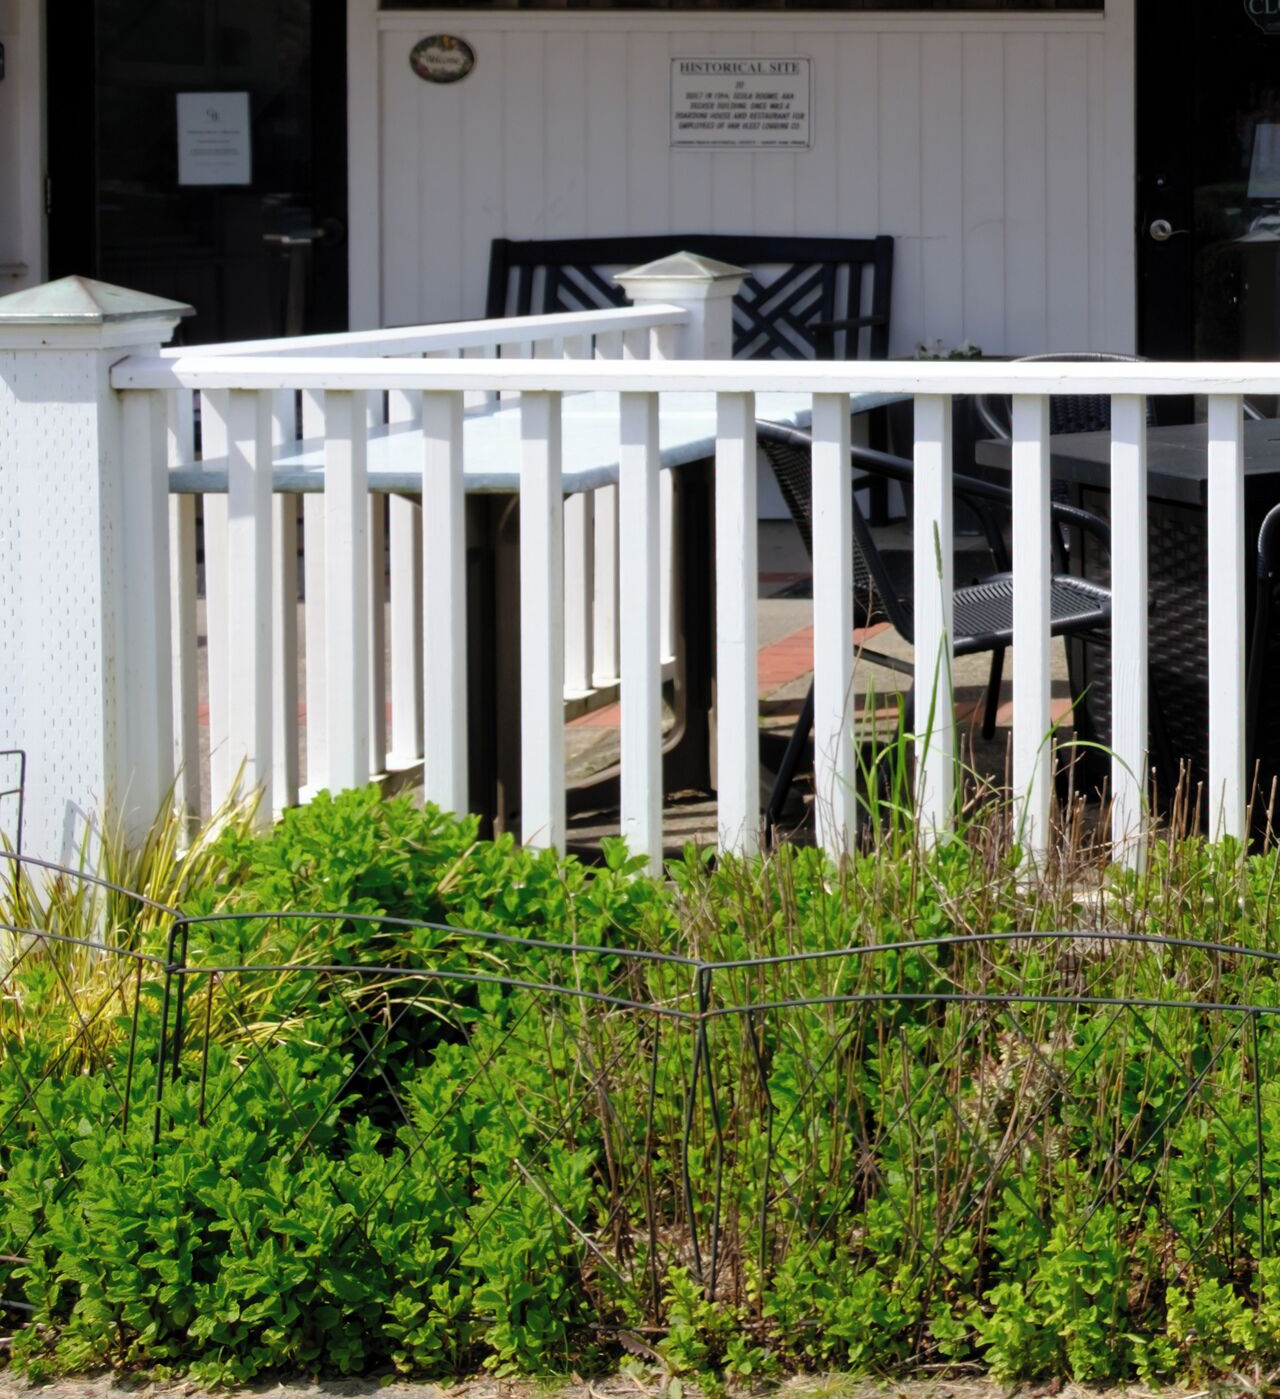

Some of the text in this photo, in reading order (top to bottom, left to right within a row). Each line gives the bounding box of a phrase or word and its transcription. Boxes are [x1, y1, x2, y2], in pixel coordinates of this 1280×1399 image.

[680, 62, 800, 73] HISTORICAL SITE
[749, 112, 790, 120] RESTAURANT
